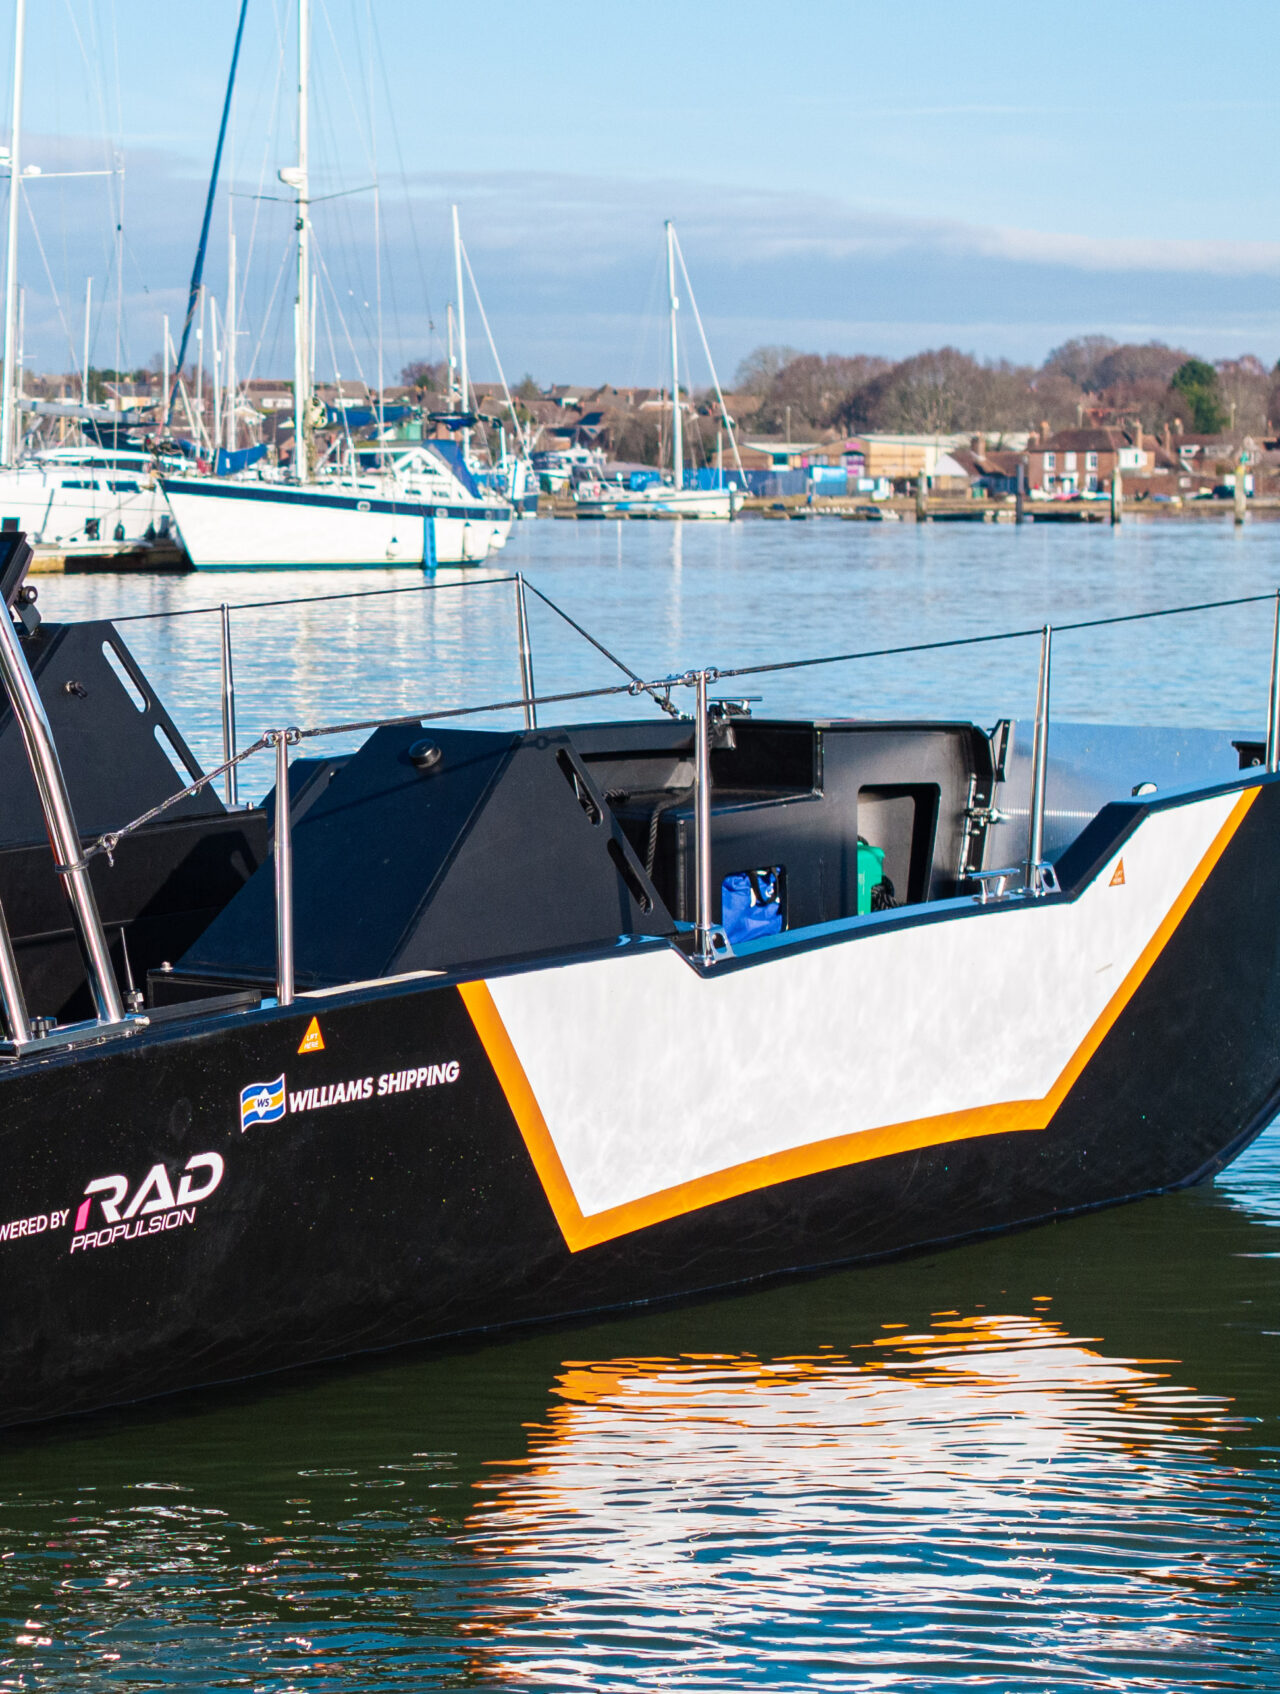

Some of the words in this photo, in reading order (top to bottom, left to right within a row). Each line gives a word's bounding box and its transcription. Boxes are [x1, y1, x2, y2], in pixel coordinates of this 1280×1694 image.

[288, 1076, 374, 1113] WILLIAMS
[376, 1060, 461, 1096] SHIPPING
[74, 1151, 225, 1232] RAD
[50, 1208, 70, 1230] BY
[70, 1207, 197, 1254] PROPULSION
